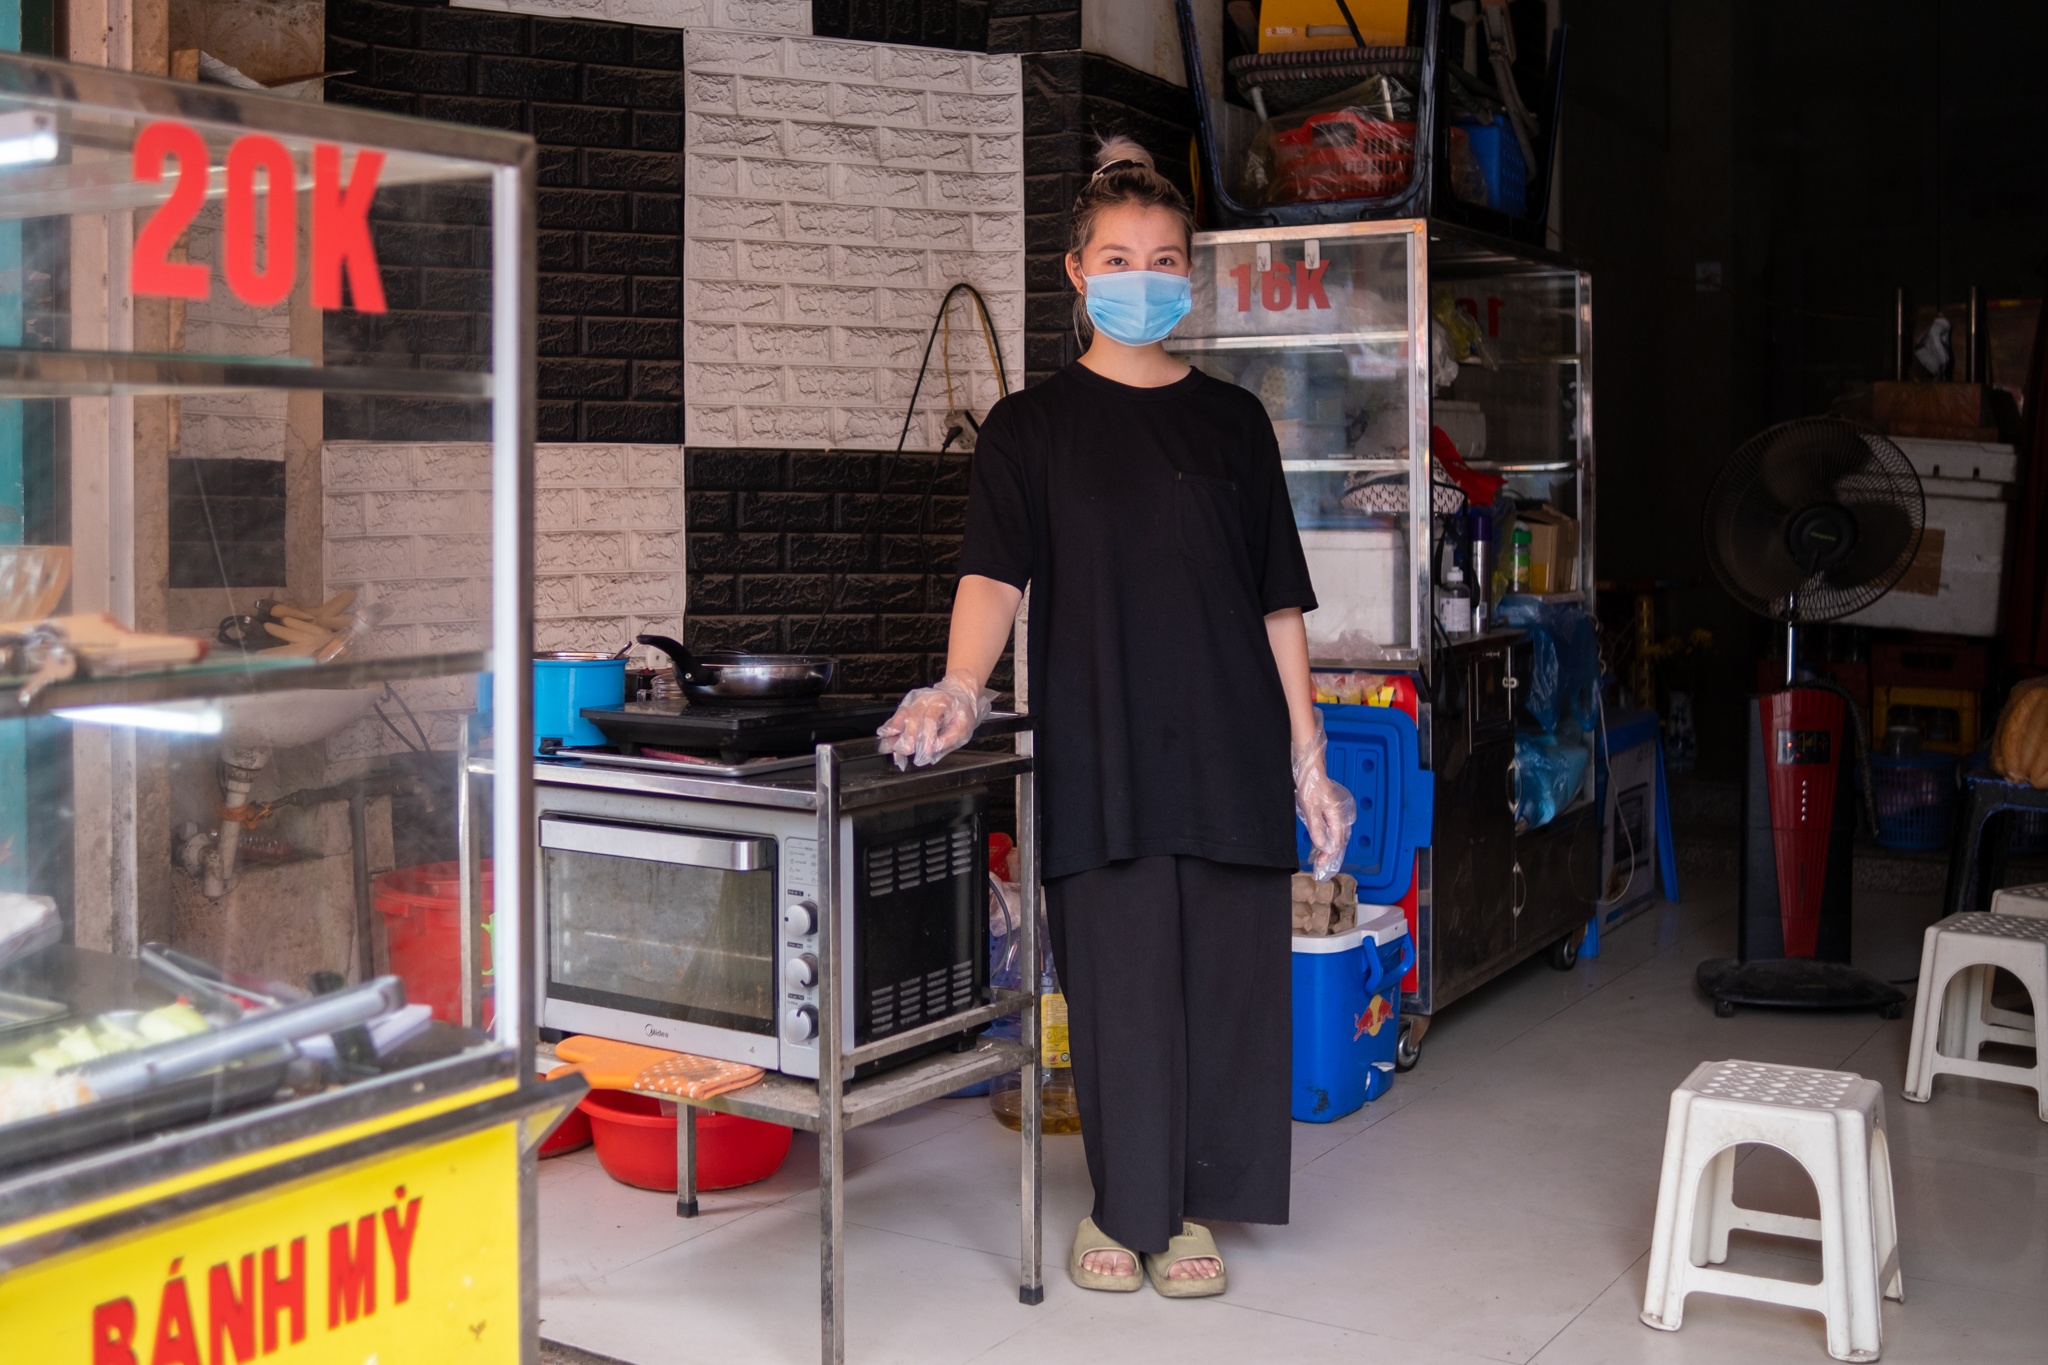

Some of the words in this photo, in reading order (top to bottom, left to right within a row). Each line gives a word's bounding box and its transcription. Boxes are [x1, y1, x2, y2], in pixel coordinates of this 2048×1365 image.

[131, 121, 388, 315] 20K
[1229, 259, 1332, 312] 16K
[645, 1023, 669, 1038] Midea
